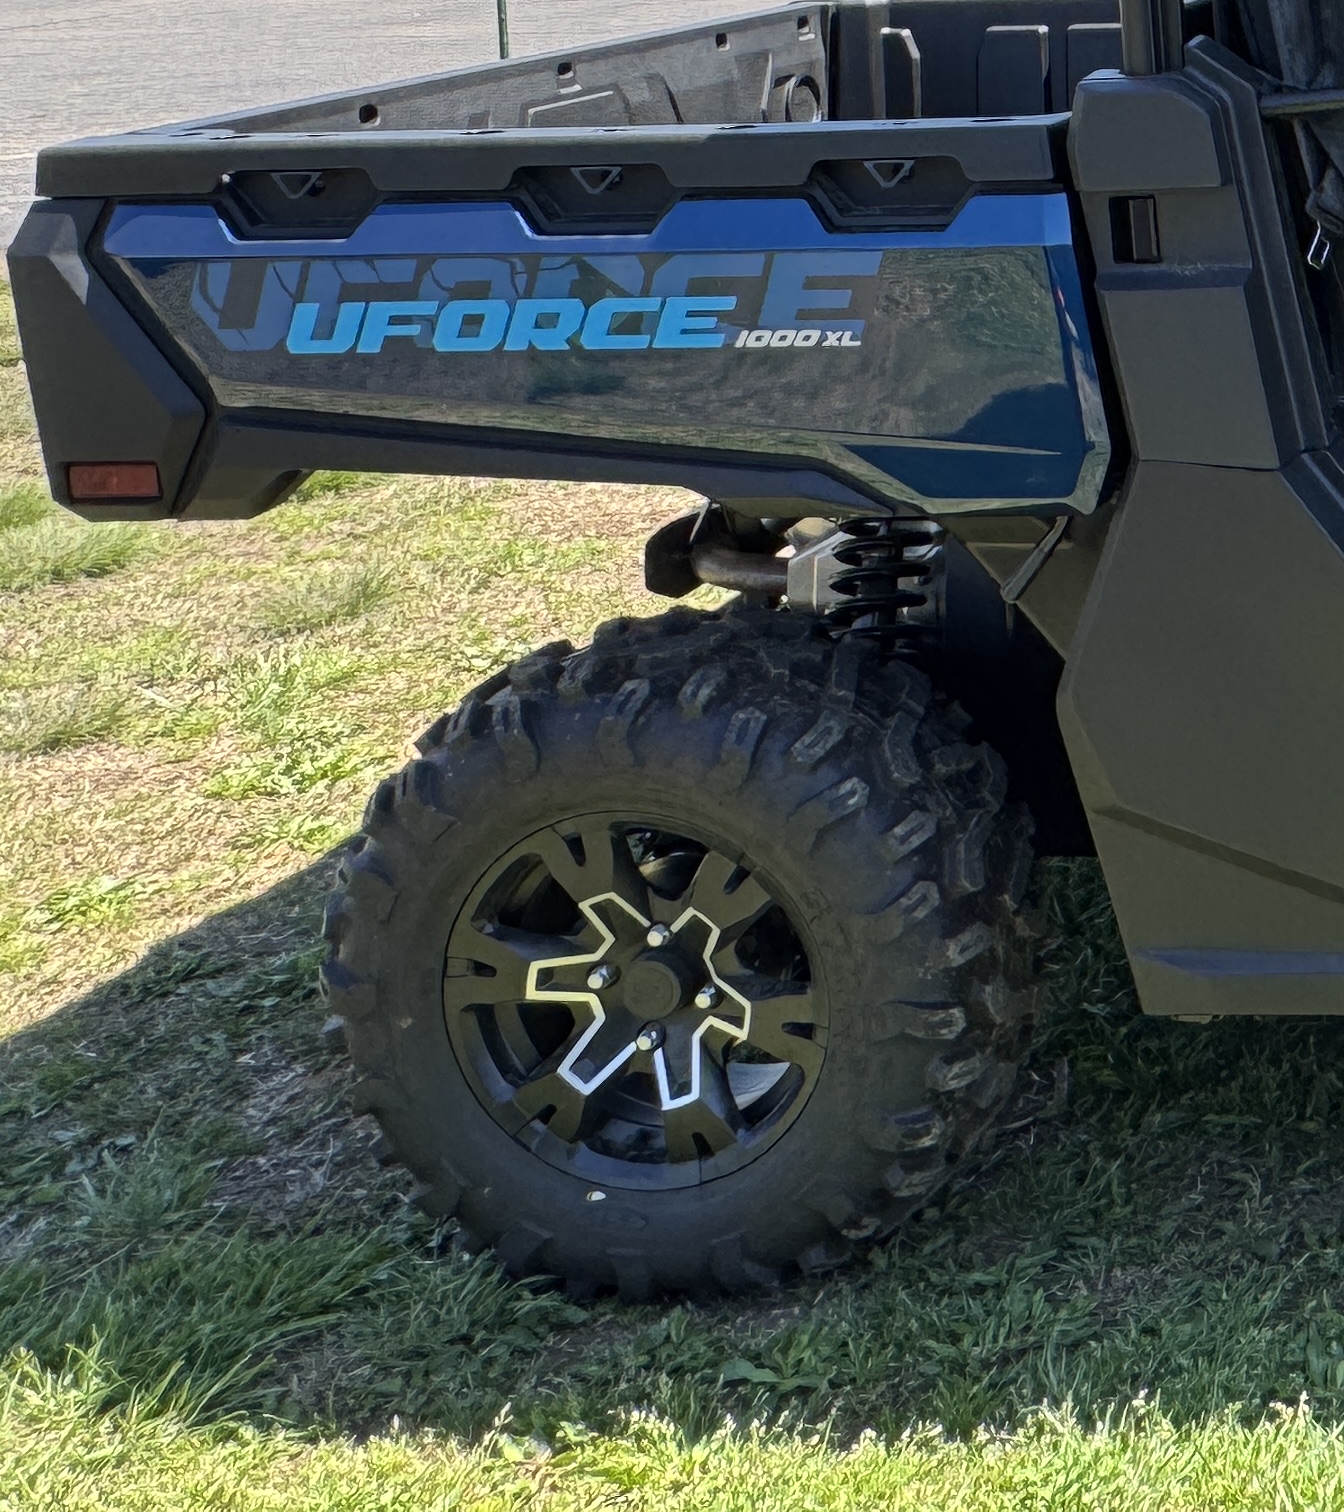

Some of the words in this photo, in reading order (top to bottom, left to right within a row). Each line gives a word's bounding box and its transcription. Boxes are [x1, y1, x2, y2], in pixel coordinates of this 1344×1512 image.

[286, 296, 737, 353] UFORCE
[734, 329, 822, 349] 1000
[822, 330, 863, 348] XL
